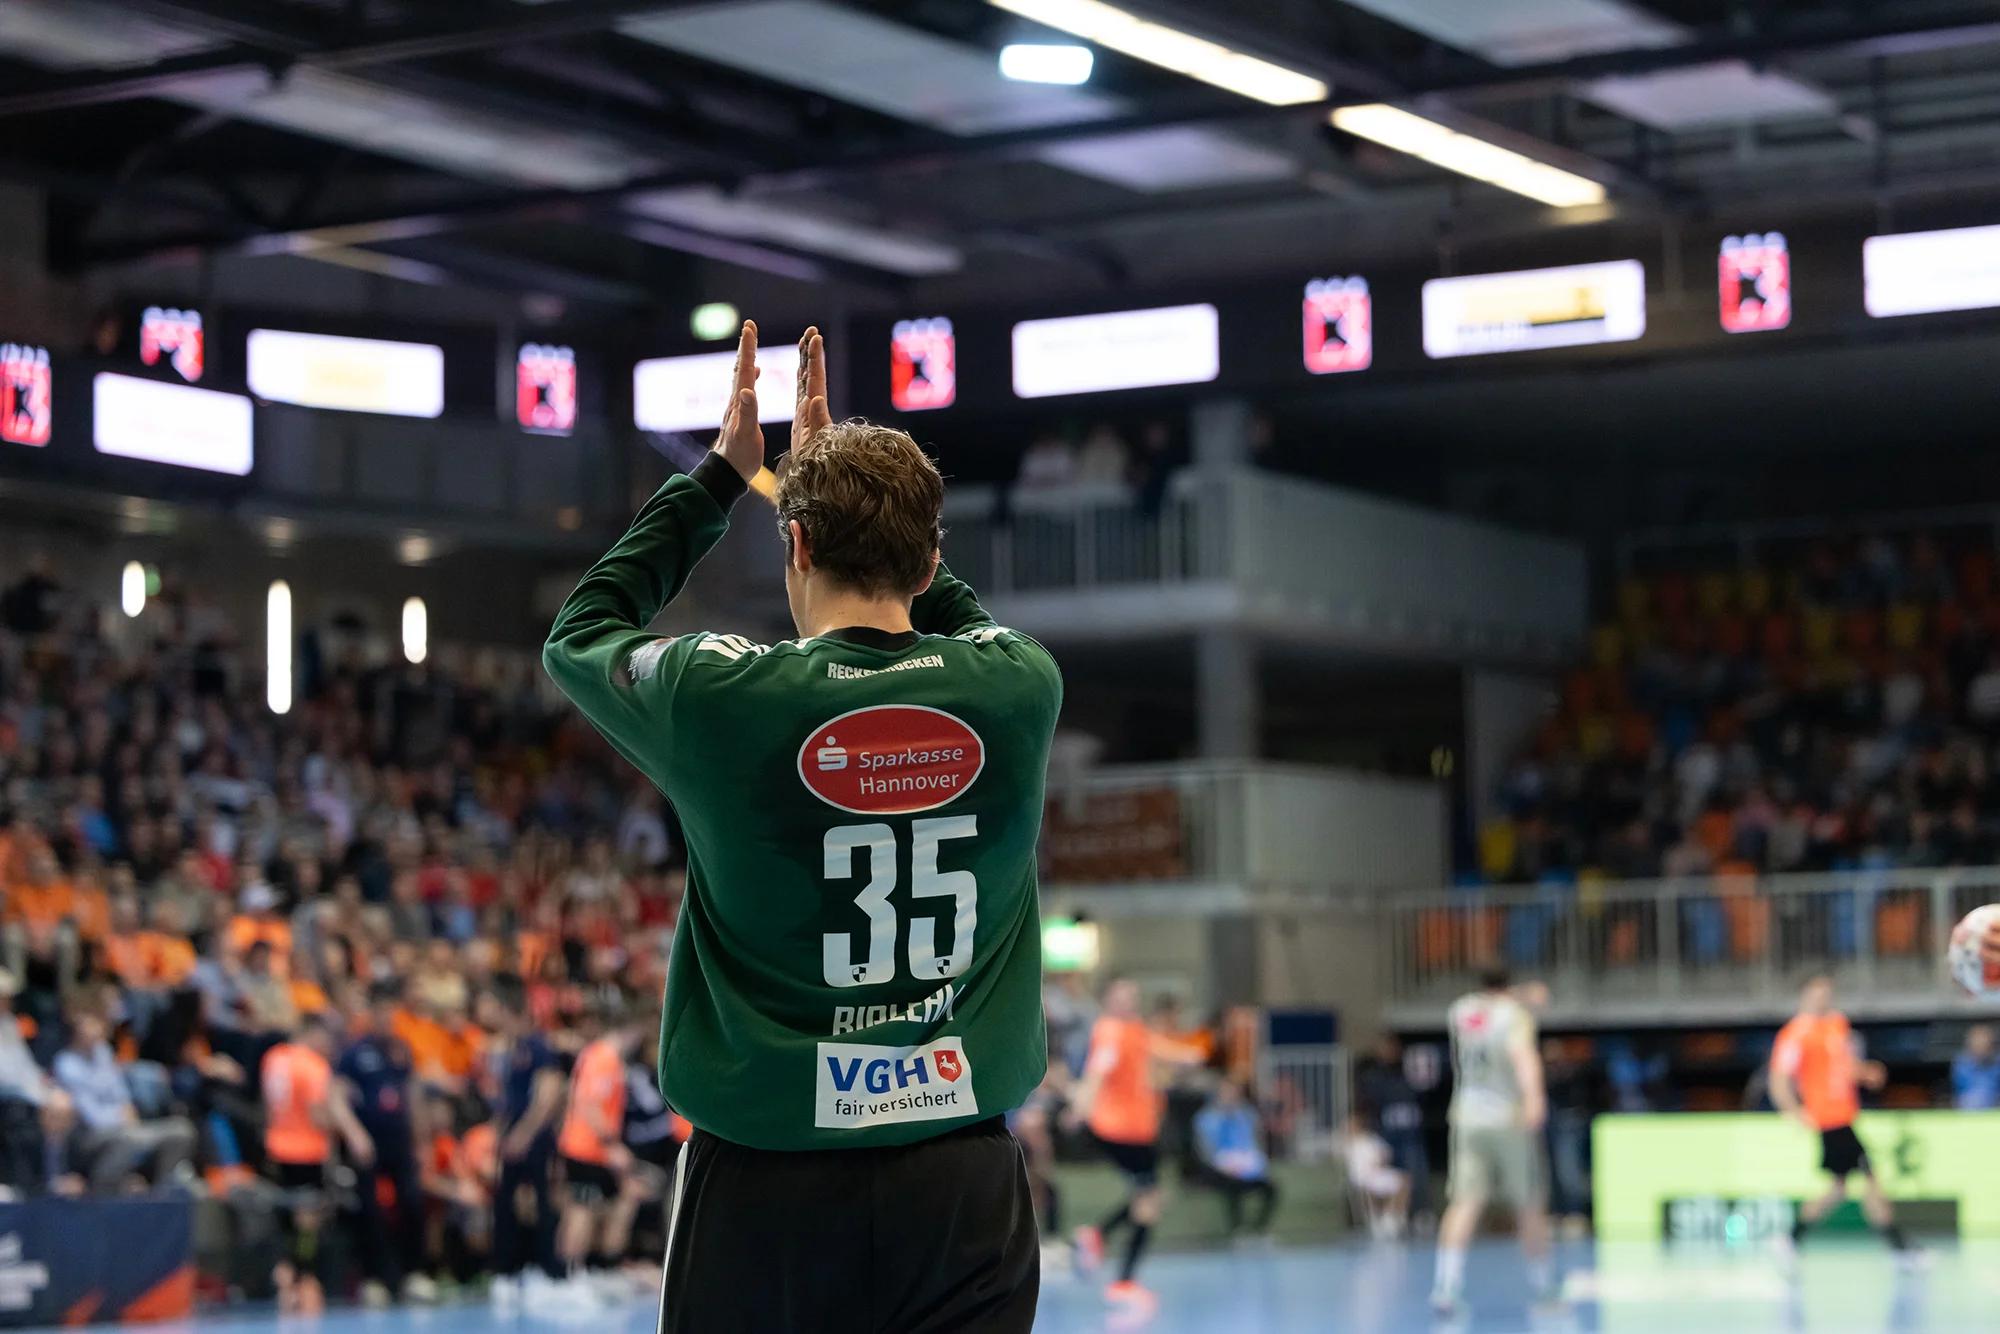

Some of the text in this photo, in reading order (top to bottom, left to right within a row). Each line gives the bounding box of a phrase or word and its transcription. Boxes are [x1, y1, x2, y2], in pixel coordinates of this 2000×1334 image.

[827, 654, 944, 679] RECKEOCKEN
[859, 748, 963, 771] Sparkasse
[860, 773, 959, 794] Hannover
[823, 814, 978, 988] 35
[826, 1056, 929, 1094] VGH
[835, 1091, 957, 1115] fair versichert
